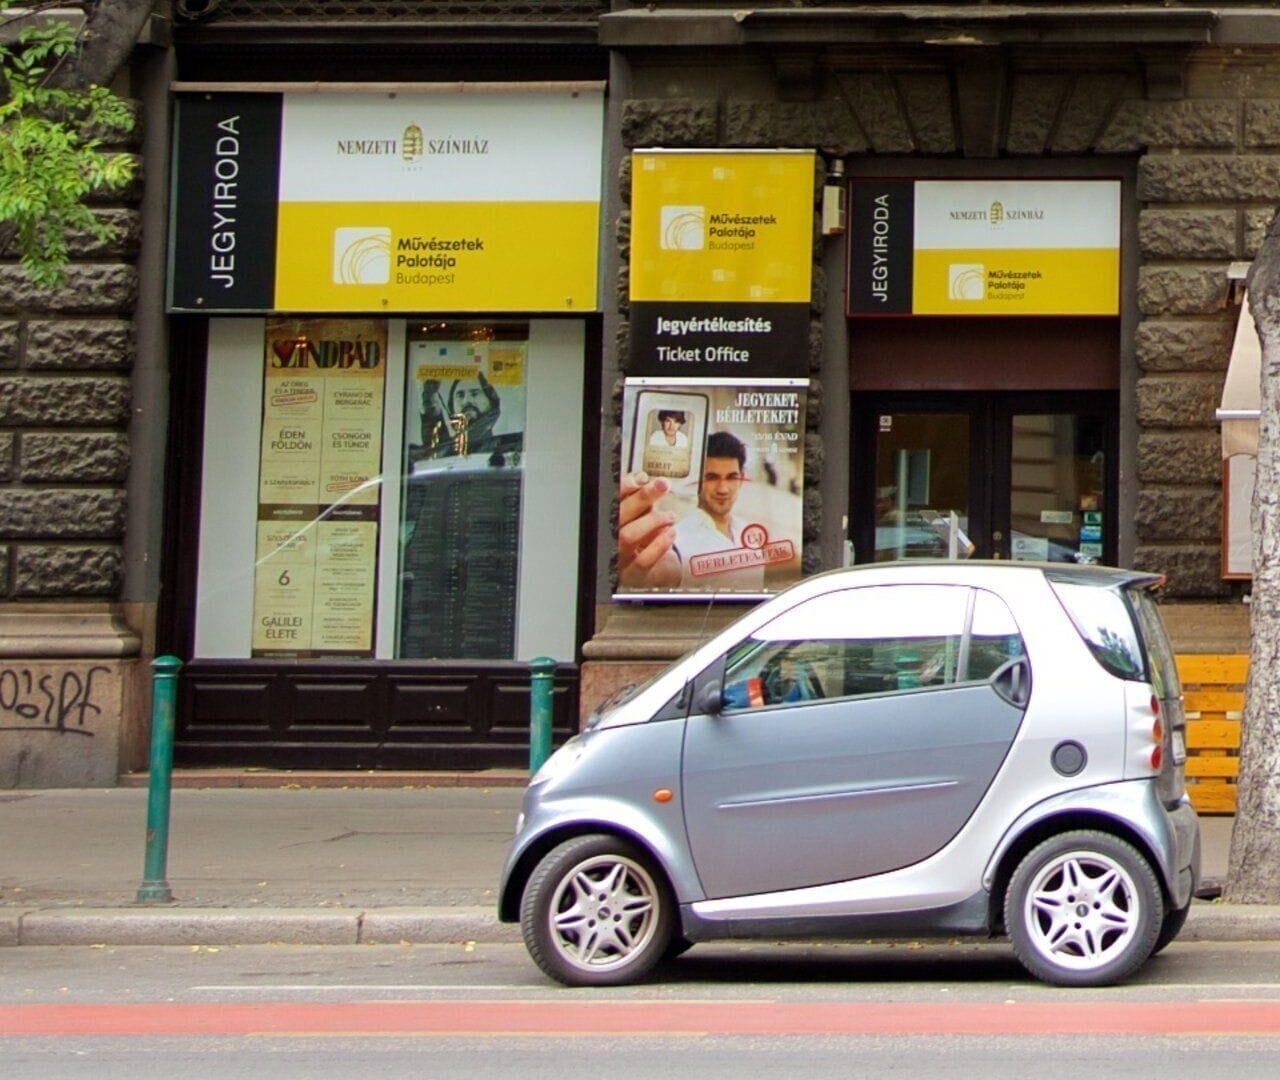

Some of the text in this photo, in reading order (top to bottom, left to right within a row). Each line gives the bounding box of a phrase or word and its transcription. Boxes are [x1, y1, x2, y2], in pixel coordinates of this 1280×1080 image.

[337, 134, 489, 154] NEMZETI SZÍNHÁZ
[211, 116, 240, 288] JEGYIRODA
[709, 214, 777, 225] Művészetek
[949, 211, 987, 221] NEMZETI
[709, 226, 756, 239] Palotája
[397, 237, 484, 251] Művészetek
[708, 240, 755, 251] Budapest
[872, 194, 890, 302] JEGYIRODA
[397, 254, 456, 270] Palotája
[396, 272, 456, 286] Budapest
[988, 269, 1042, 279] Művészetek
[987, 280, 1025, 291] Palotája
[656, 317, 772, 335] Jegyértékesítés
[656, 346, 750, 362] Ticket Office
[716, 406, 799, 424] BÉRLETEKET!
[278, 569, 290, 586] 6
